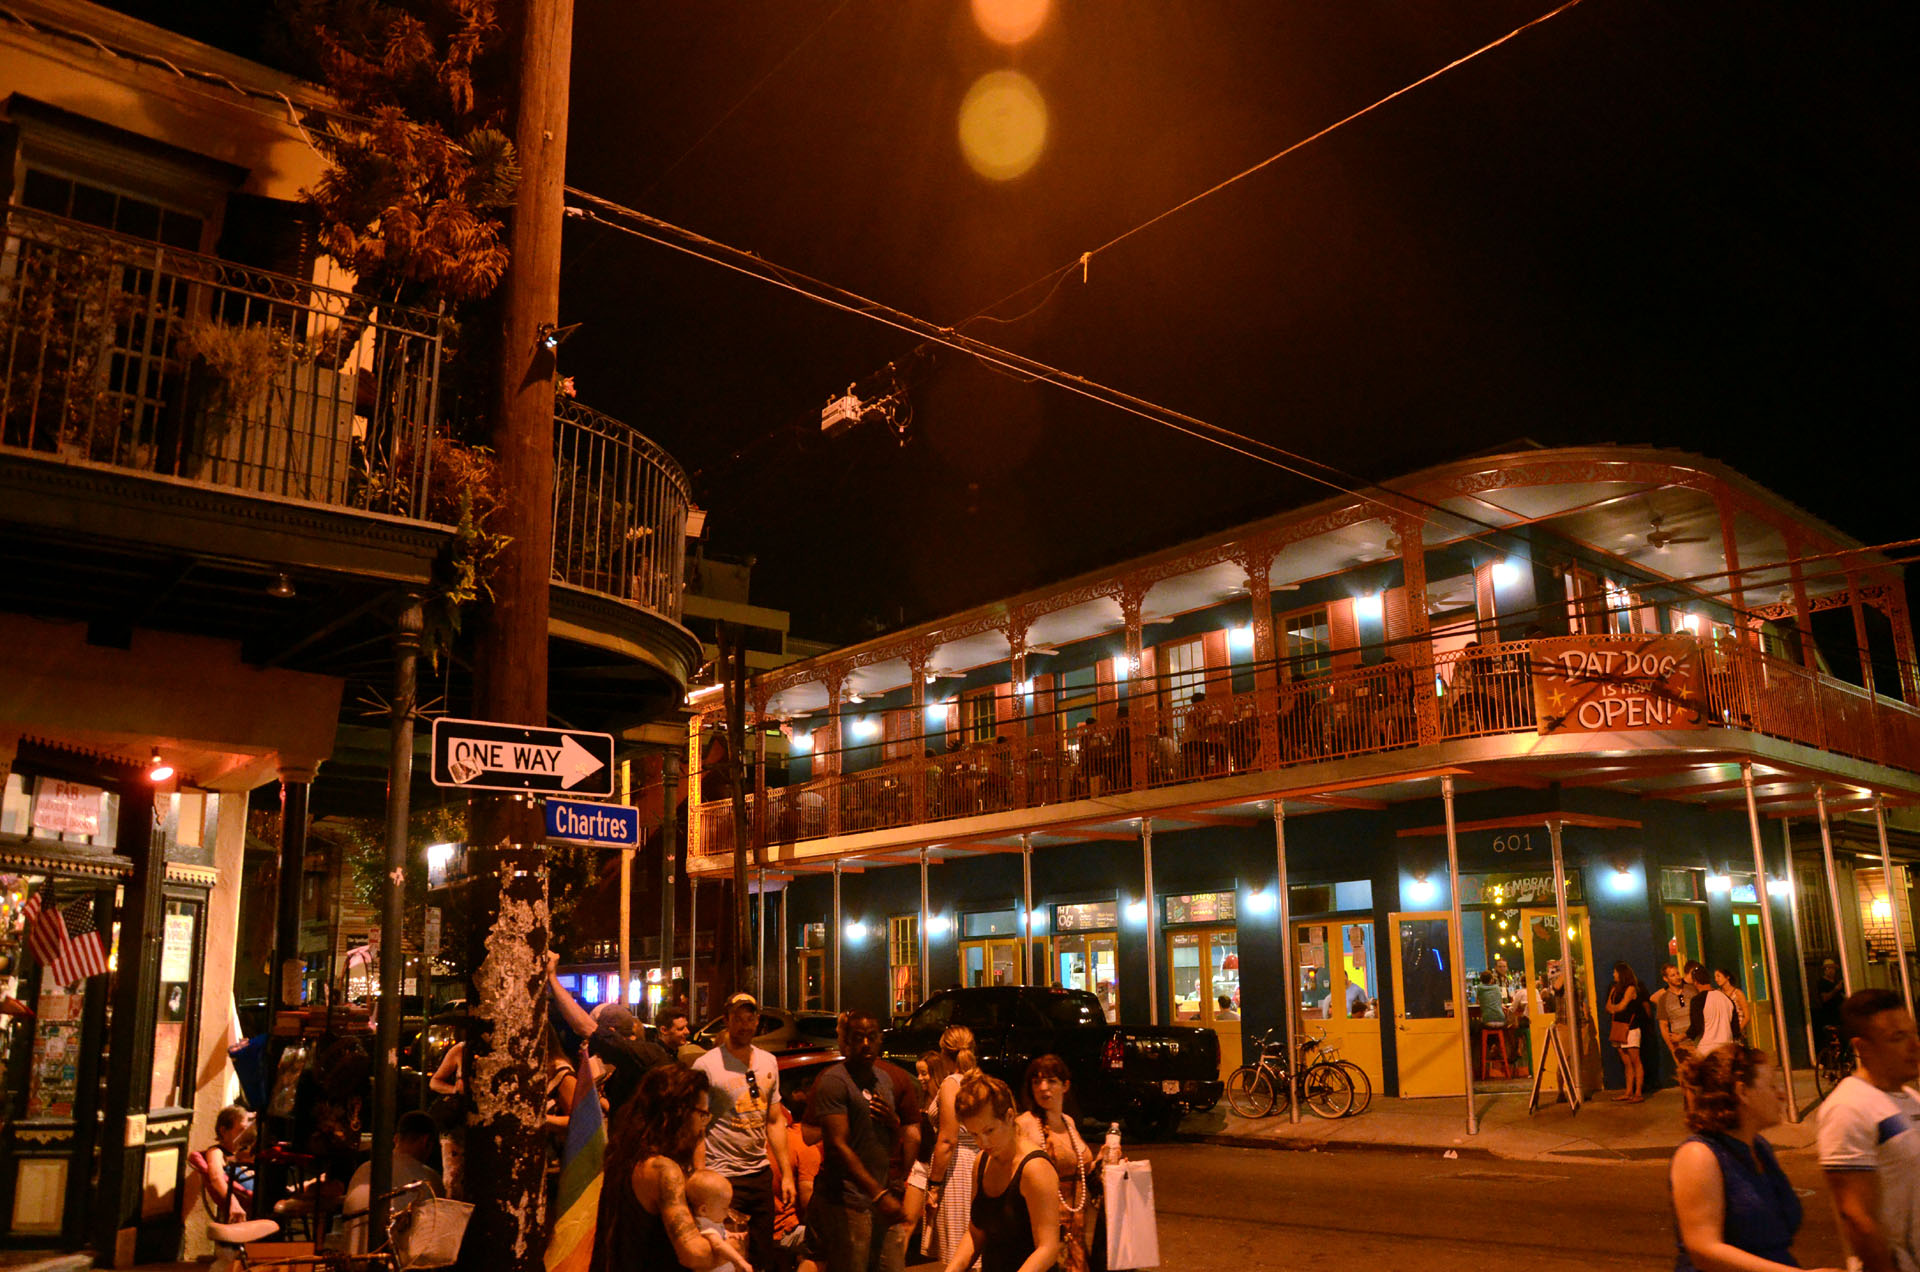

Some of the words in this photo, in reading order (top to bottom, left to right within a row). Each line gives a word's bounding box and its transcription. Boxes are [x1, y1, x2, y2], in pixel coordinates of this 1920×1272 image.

[1558, 650, 1619, 683] DAT
[1622, 650, 1677, 678] DOG
[1578, 696, 1672, 729] OPEN!
[455, 741, 504, 768] ONE
[513, 746, 562, 772] WAY
[555, 805, 628, 839] Chartres
[1492, 833, 1533, 853] 601
